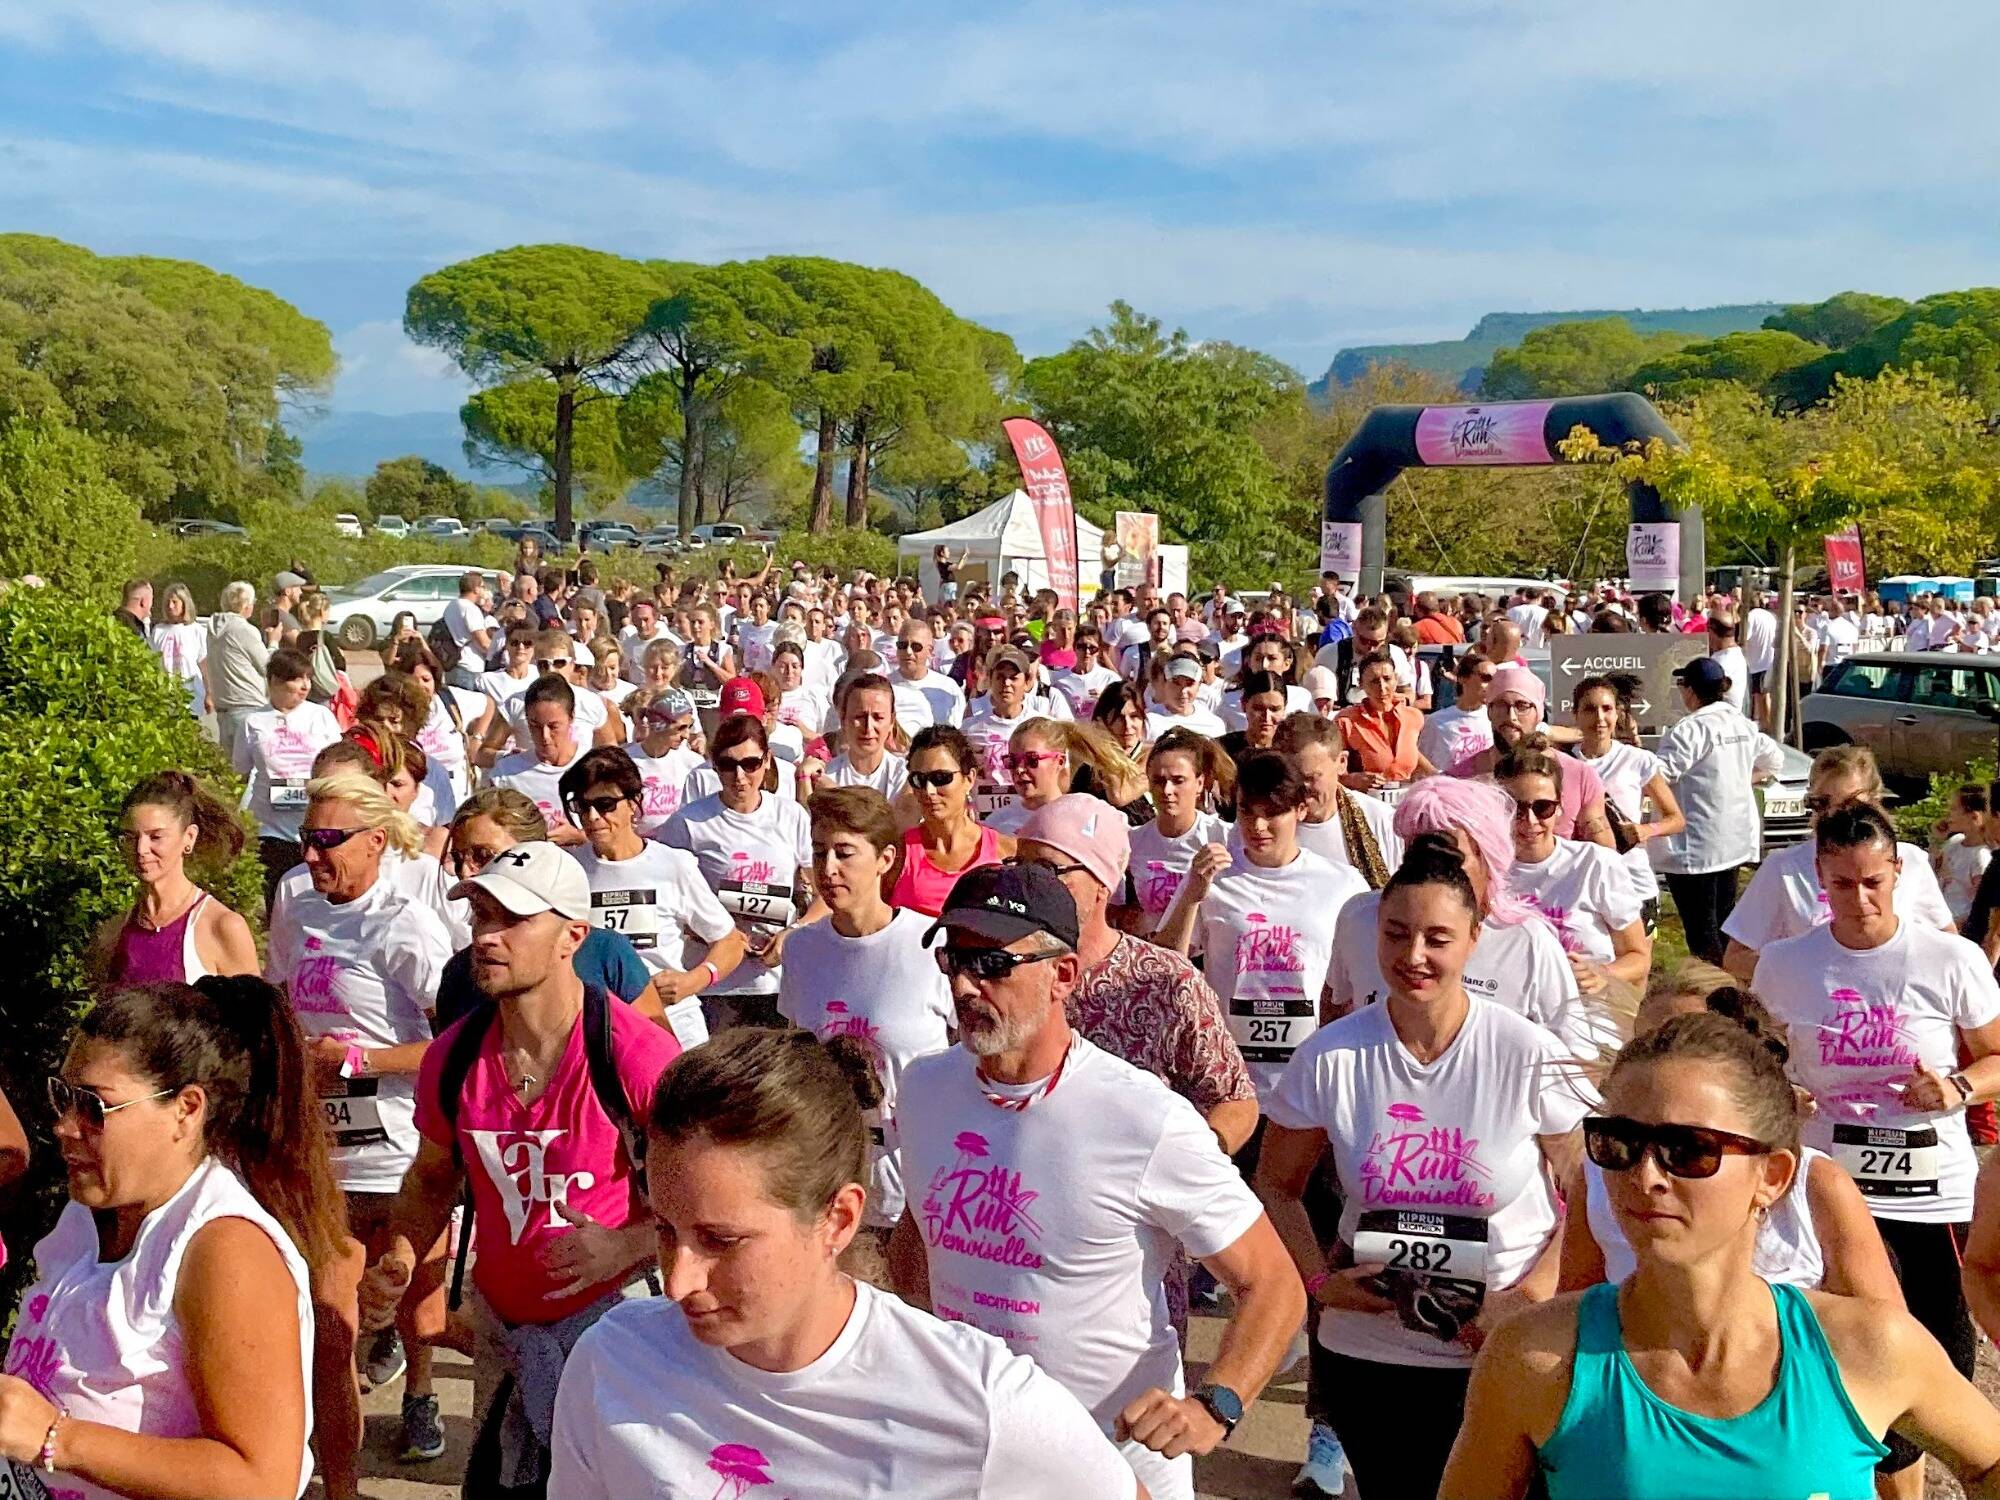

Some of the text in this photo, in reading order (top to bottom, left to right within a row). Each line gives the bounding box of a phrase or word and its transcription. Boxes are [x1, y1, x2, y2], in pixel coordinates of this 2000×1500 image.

[1584, 656, 1646, 669] ACCUEIL
[1772, 801, 1787, 813] 272
[737, 896, 771, 915] 127
[604, 909, 629, 929] 57
[1249, 1020, 1292, 1042] 257
[1387, 1128, 1467, 1188] Run
[1860, 1150, 1912, 1175] 274
[946, 1166, 1018, 1234] Run
[1360, 1175, 1495, 1206] Demoiselles
[1399, 1212, 1444, 1224] KIPRUN
[923, 1214, 1044, 1269] Demoiselles
[1389, 1239, 1452, 1274] 282
[973, 1291, 1040, 1314] DECATHLON
